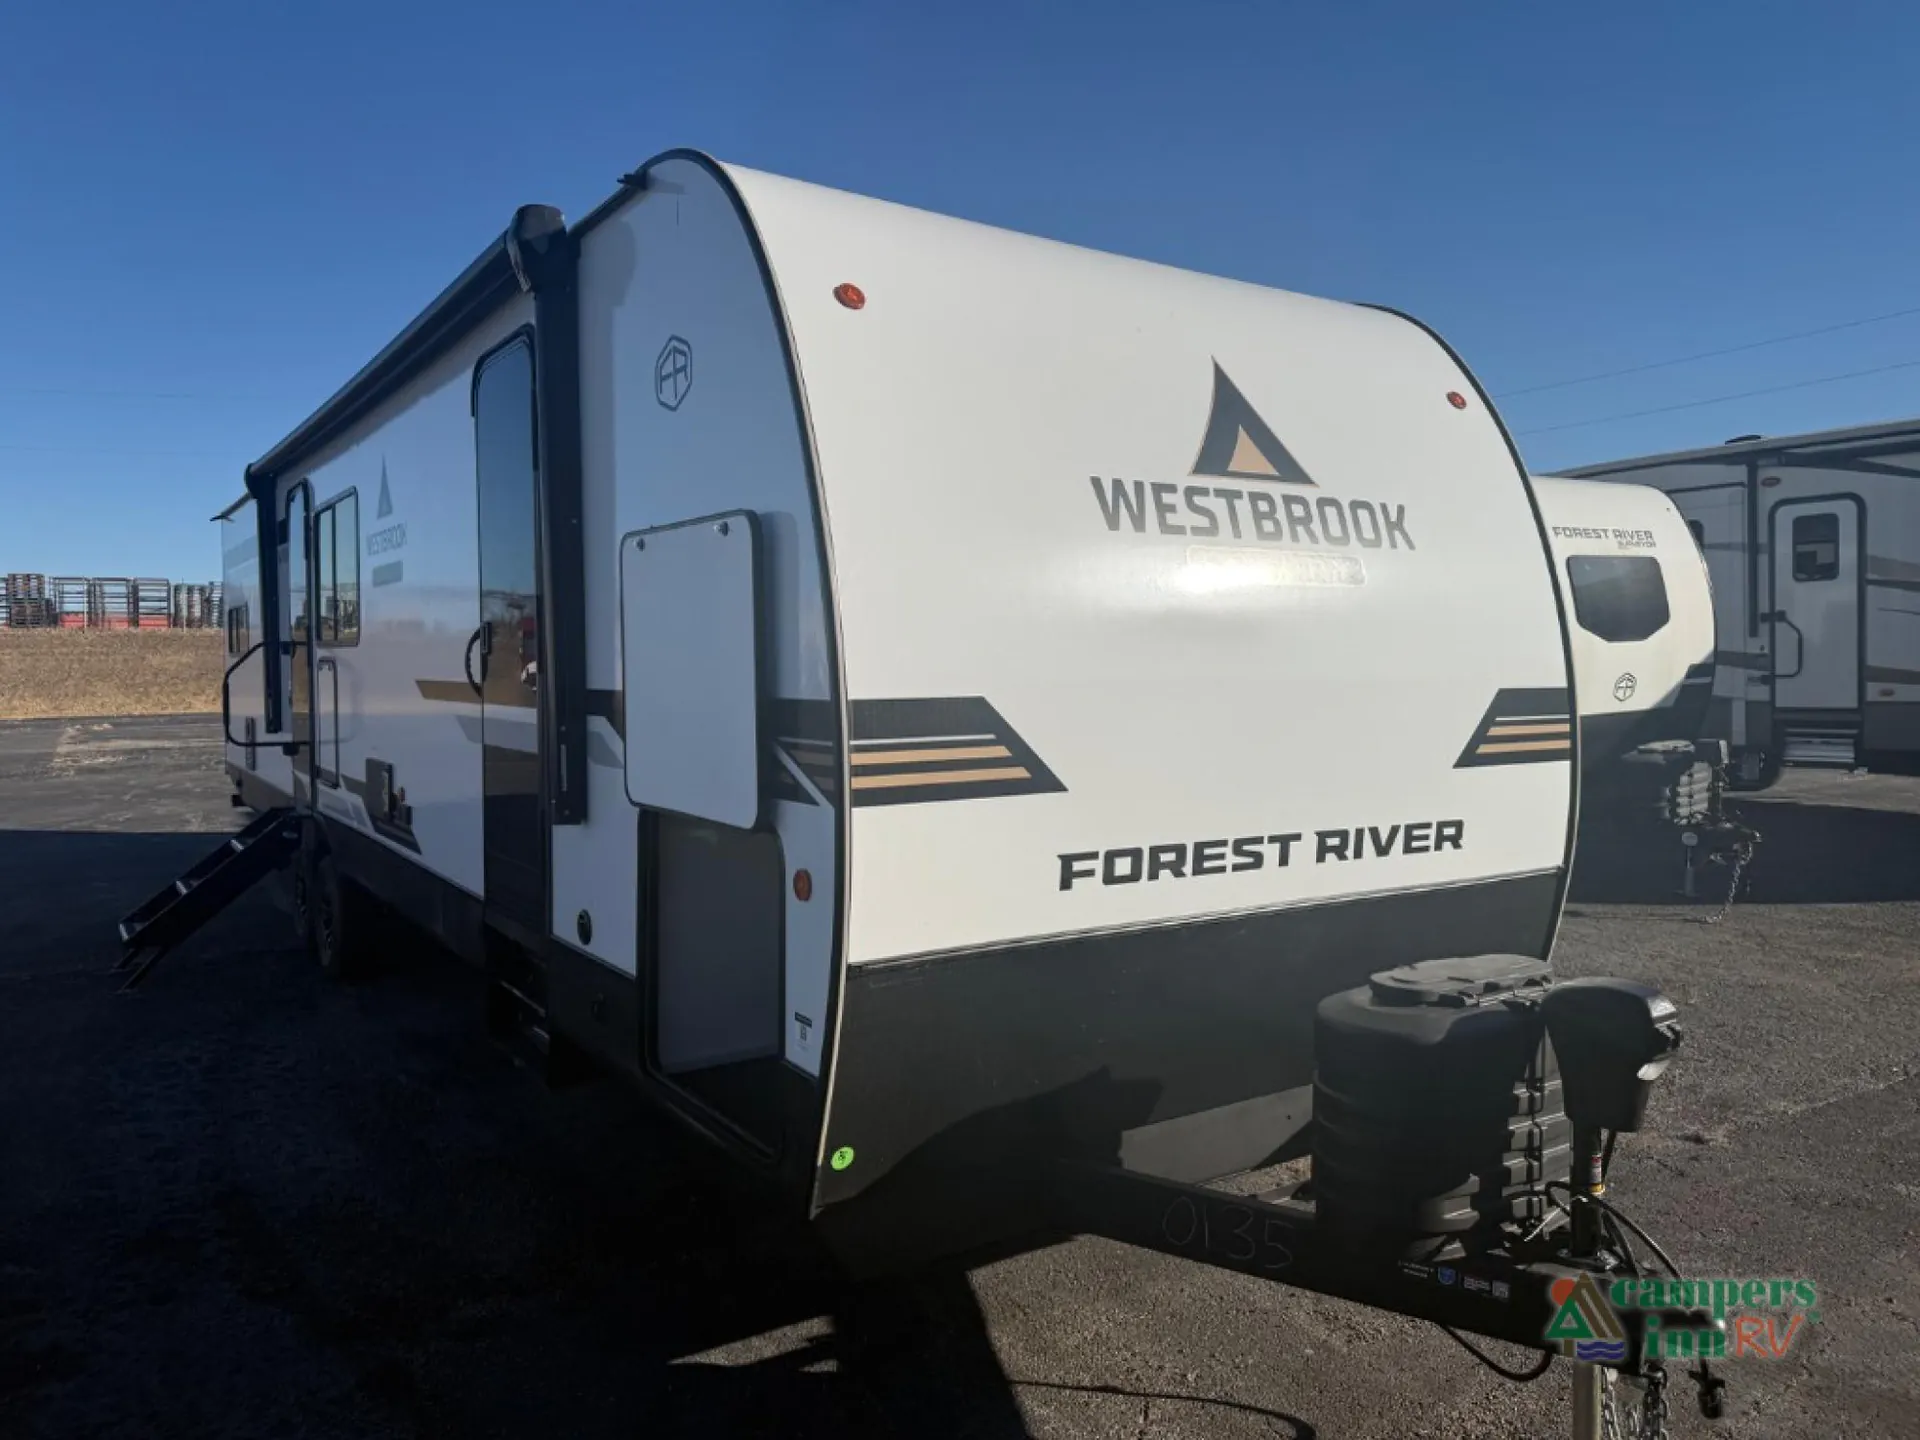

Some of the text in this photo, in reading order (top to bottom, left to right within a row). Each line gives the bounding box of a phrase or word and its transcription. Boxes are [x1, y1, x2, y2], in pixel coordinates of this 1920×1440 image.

[366, 521, 408, 556] WESTBROOK
[1090, 475, 1416, 551] WESTBROOK
[1552, 526, 1654, 541] FOREST RIVER
[1057, 819, 1465, 891] FOREST RIVER
[1162, 1196, 1295, 1268] 0135
